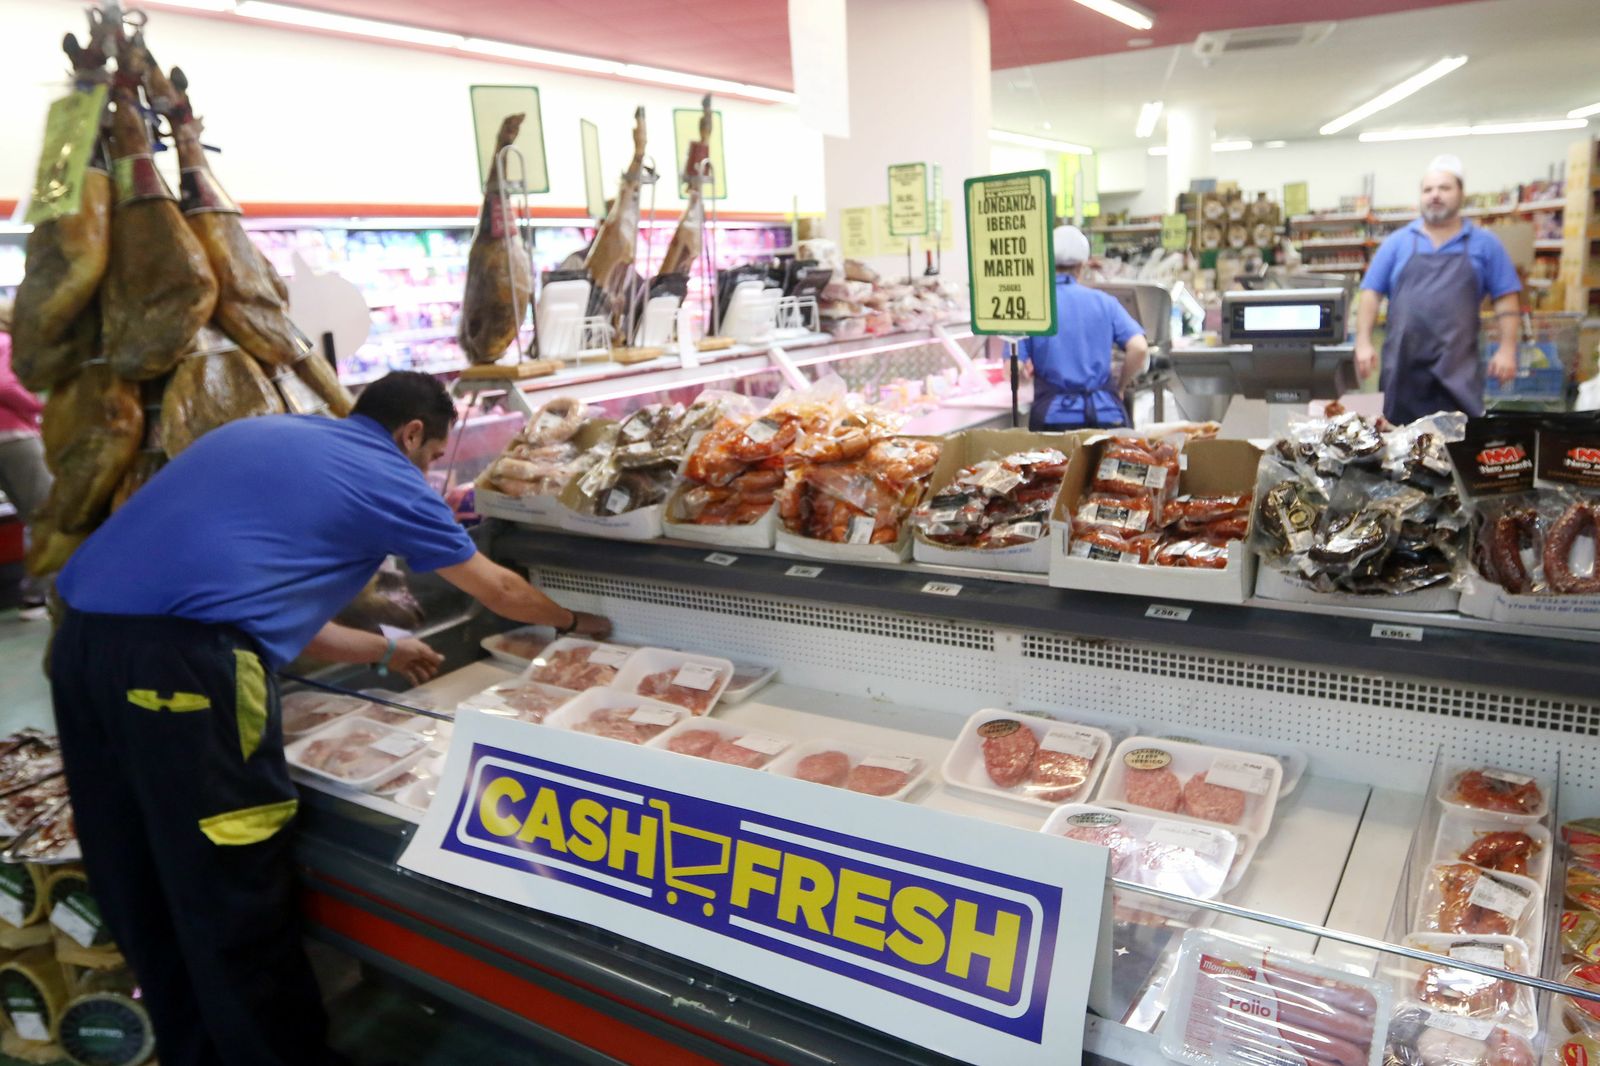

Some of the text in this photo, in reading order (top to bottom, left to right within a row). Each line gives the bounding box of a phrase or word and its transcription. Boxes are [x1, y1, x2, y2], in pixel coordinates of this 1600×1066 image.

[977, 195, 1037, 215] LONGANIZA
[986, 214, 1027, 232] IBERCA
[989, 237, 1027, 255] NIETO
[984, 259, 1035, 277] MARTIN
[478, 776, 1022, 993] CASH FRESH
